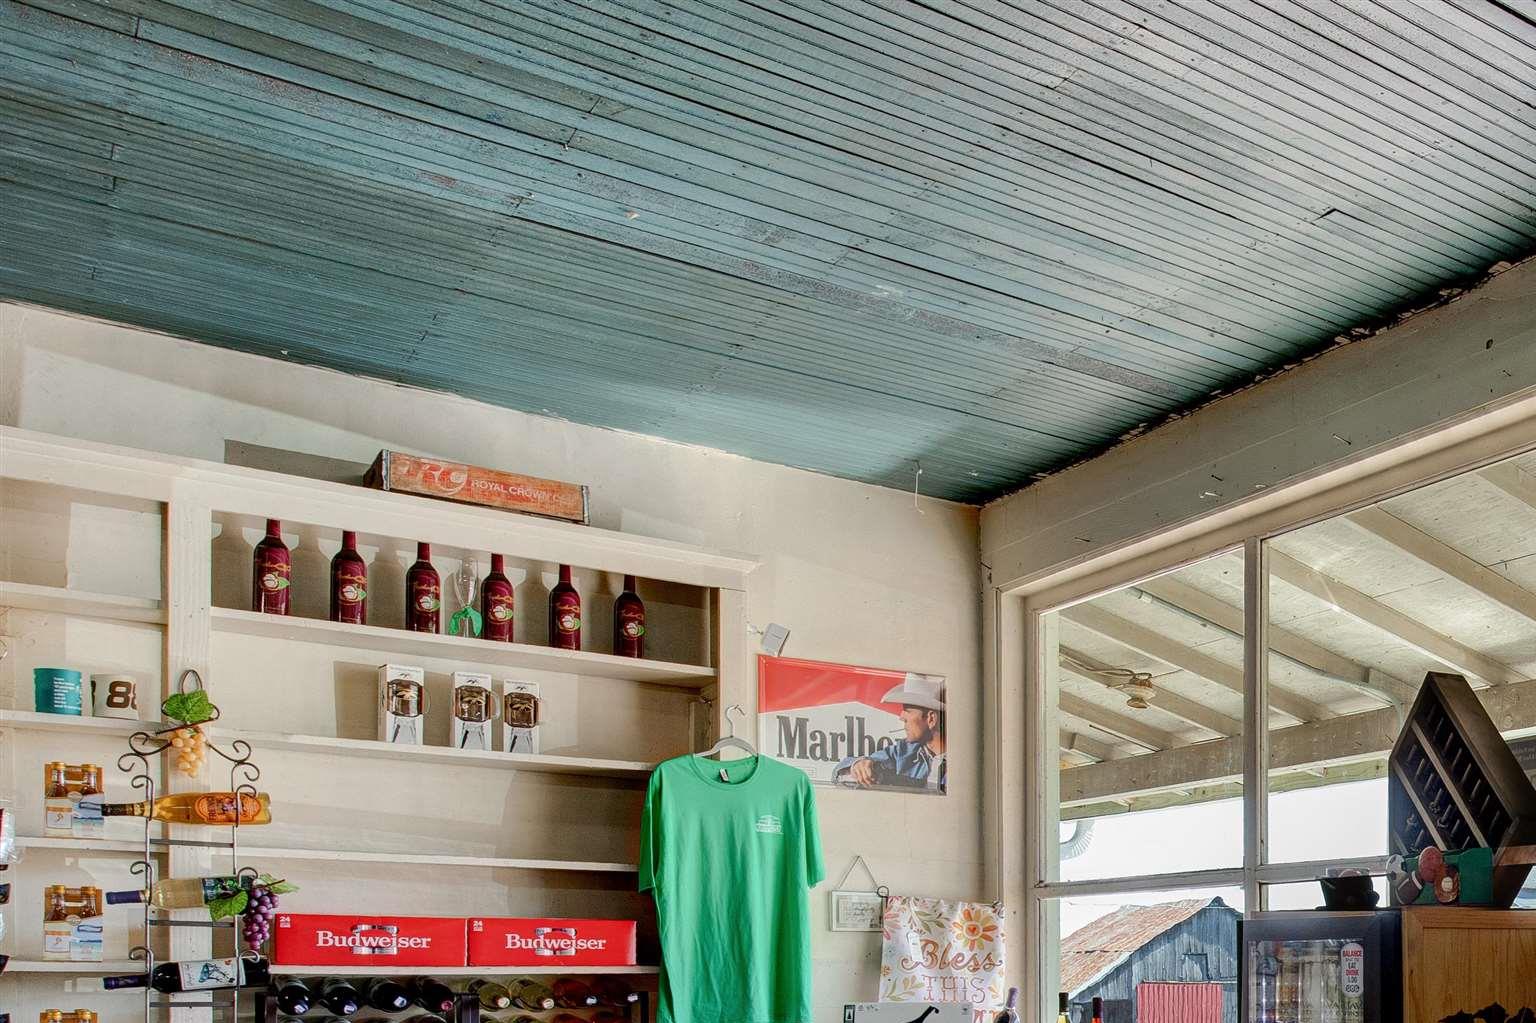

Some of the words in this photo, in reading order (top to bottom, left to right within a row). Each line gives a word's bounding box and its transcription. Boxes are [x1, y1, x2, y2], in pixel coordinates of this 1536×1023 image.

[471, 479, 508, 495] ROYAL
[776, 714, 902, 763] Marlbo
[316, 929, 432, 949] Budweiser
[505, 933, 607, 951] Budweiser
[901, 938, 1003, 973] Bless
[920, 974, 986, 1004] THIS
